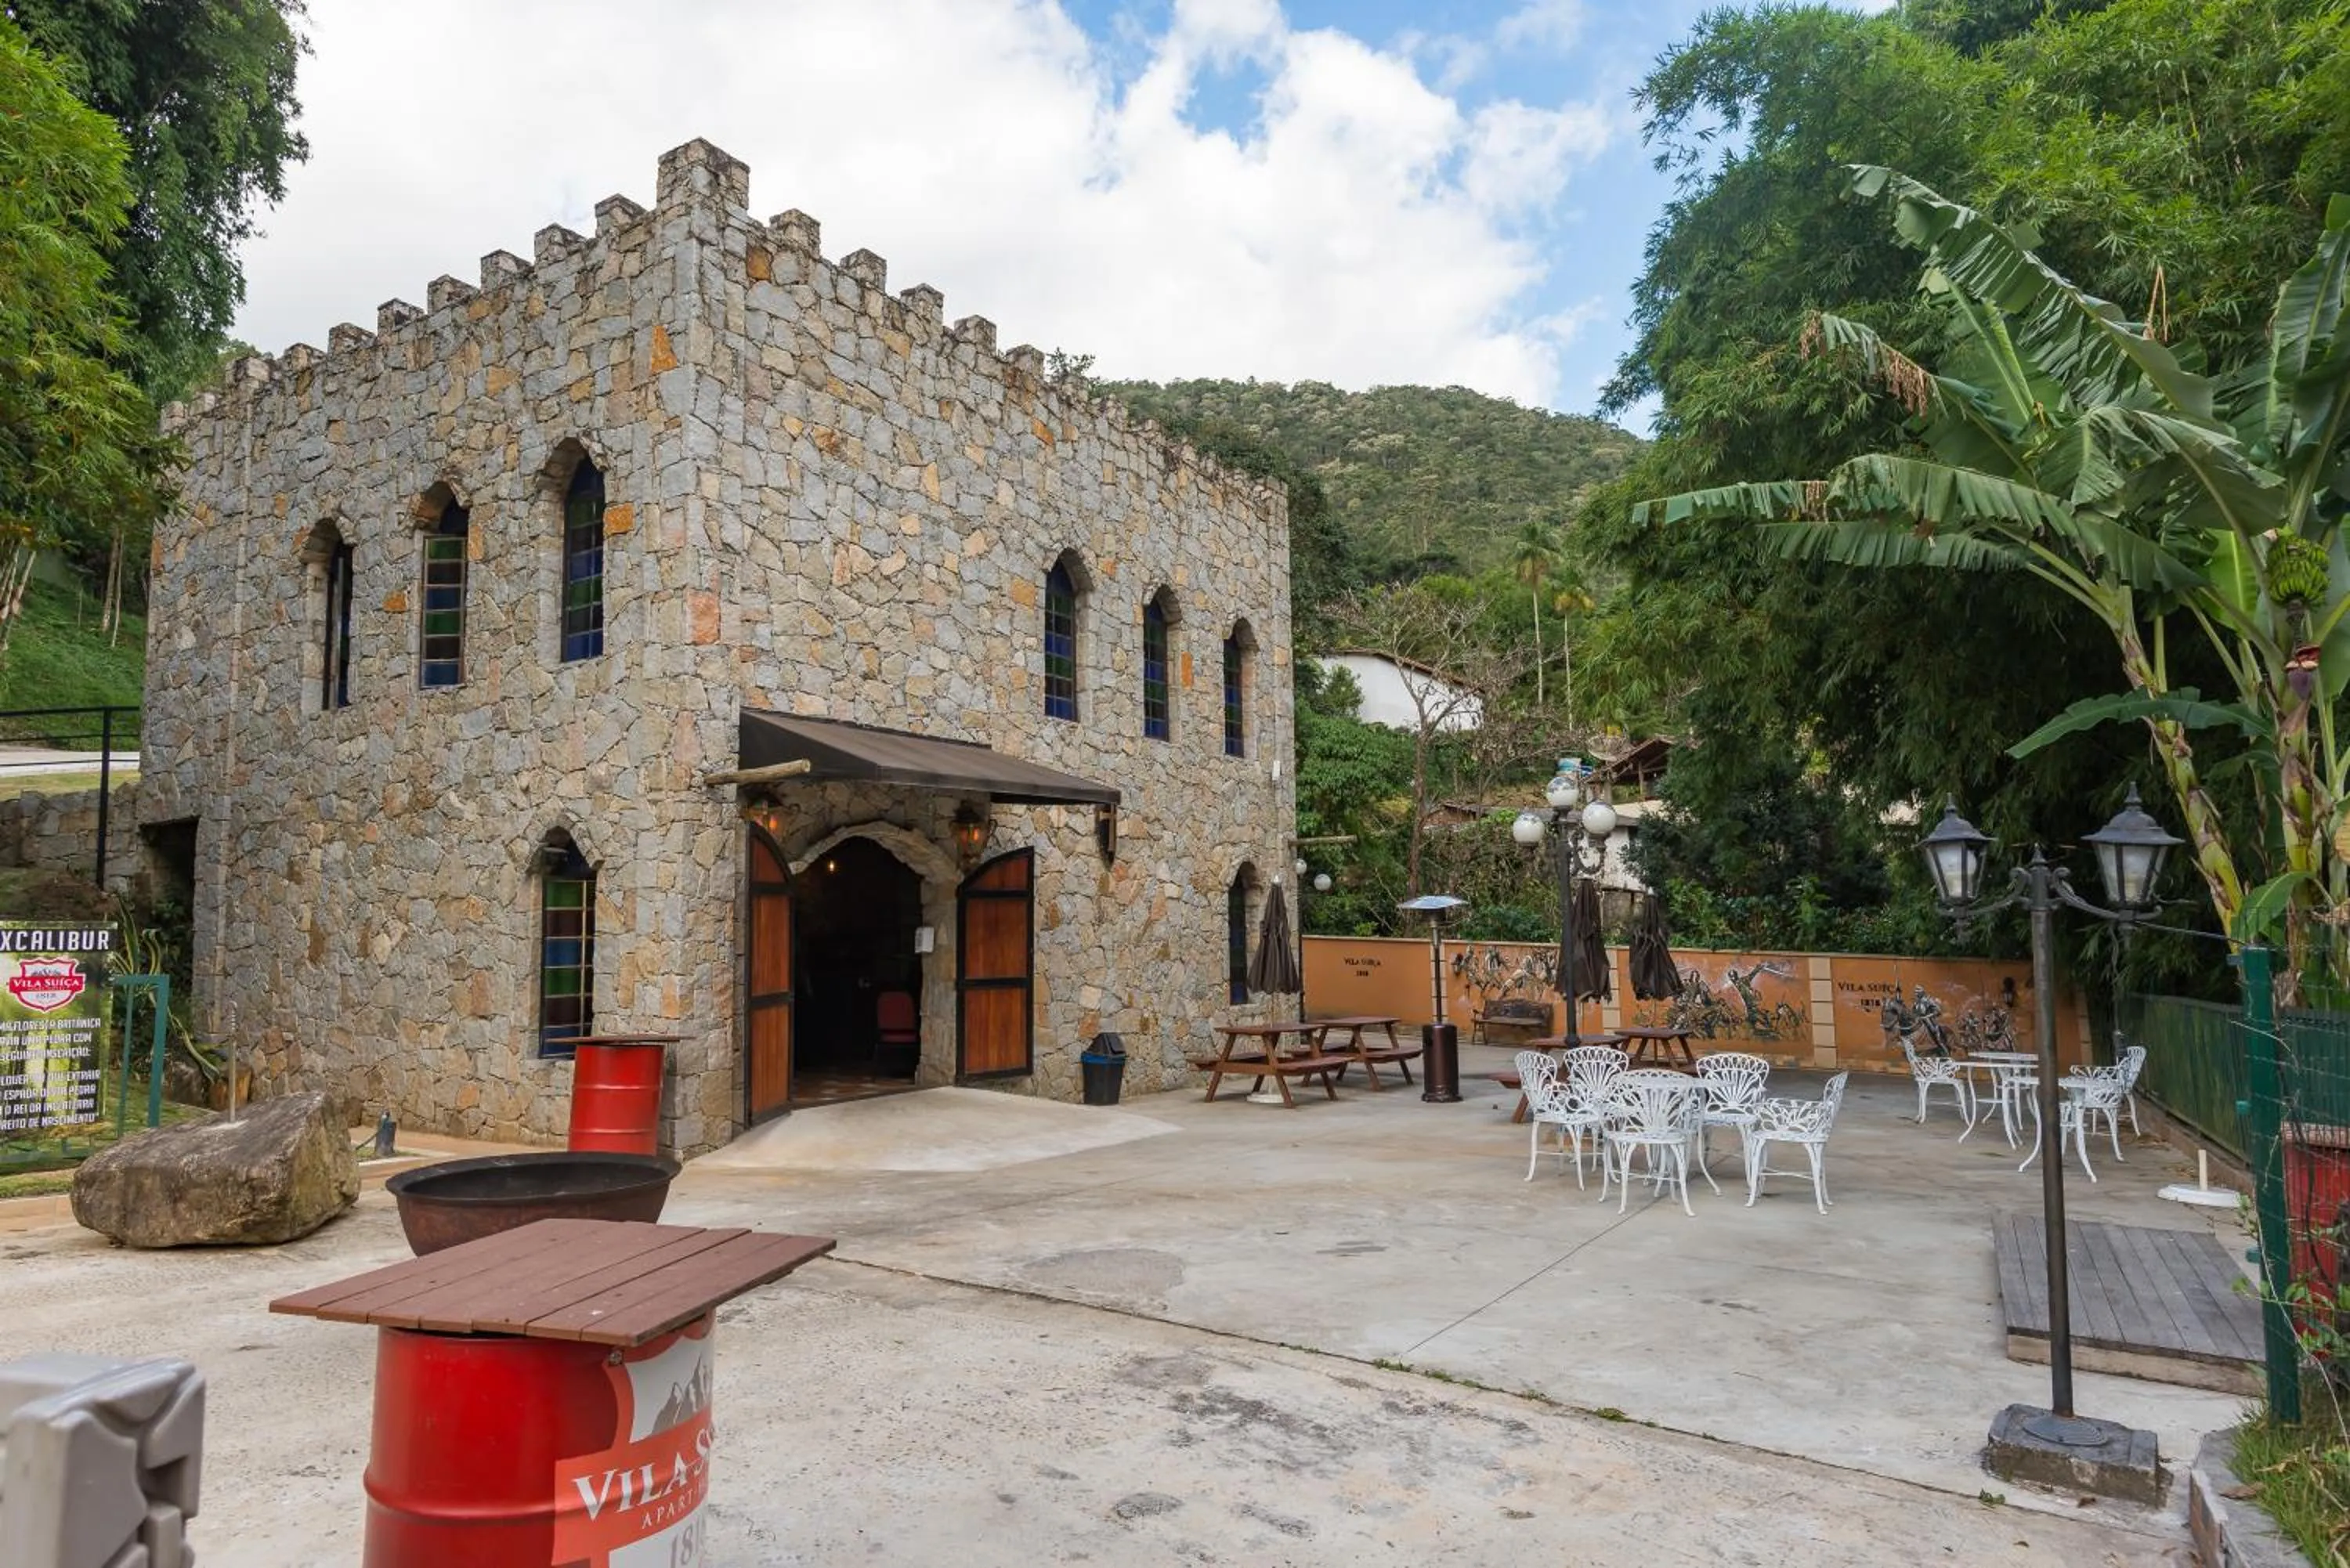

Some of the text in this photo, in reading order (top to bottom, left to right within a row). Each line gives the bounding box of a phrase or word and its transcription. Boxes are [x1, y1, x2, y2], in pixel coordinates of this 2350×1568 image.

[0, 930, 110, 950] XCALIBUR
[13, 976, 80, 988] VILA SUÍÇA
[1838, 982, 1864, 992] VILA
[570, 1451, 689, 1523] VILA
[670, 1513, 706, 1568] 181
